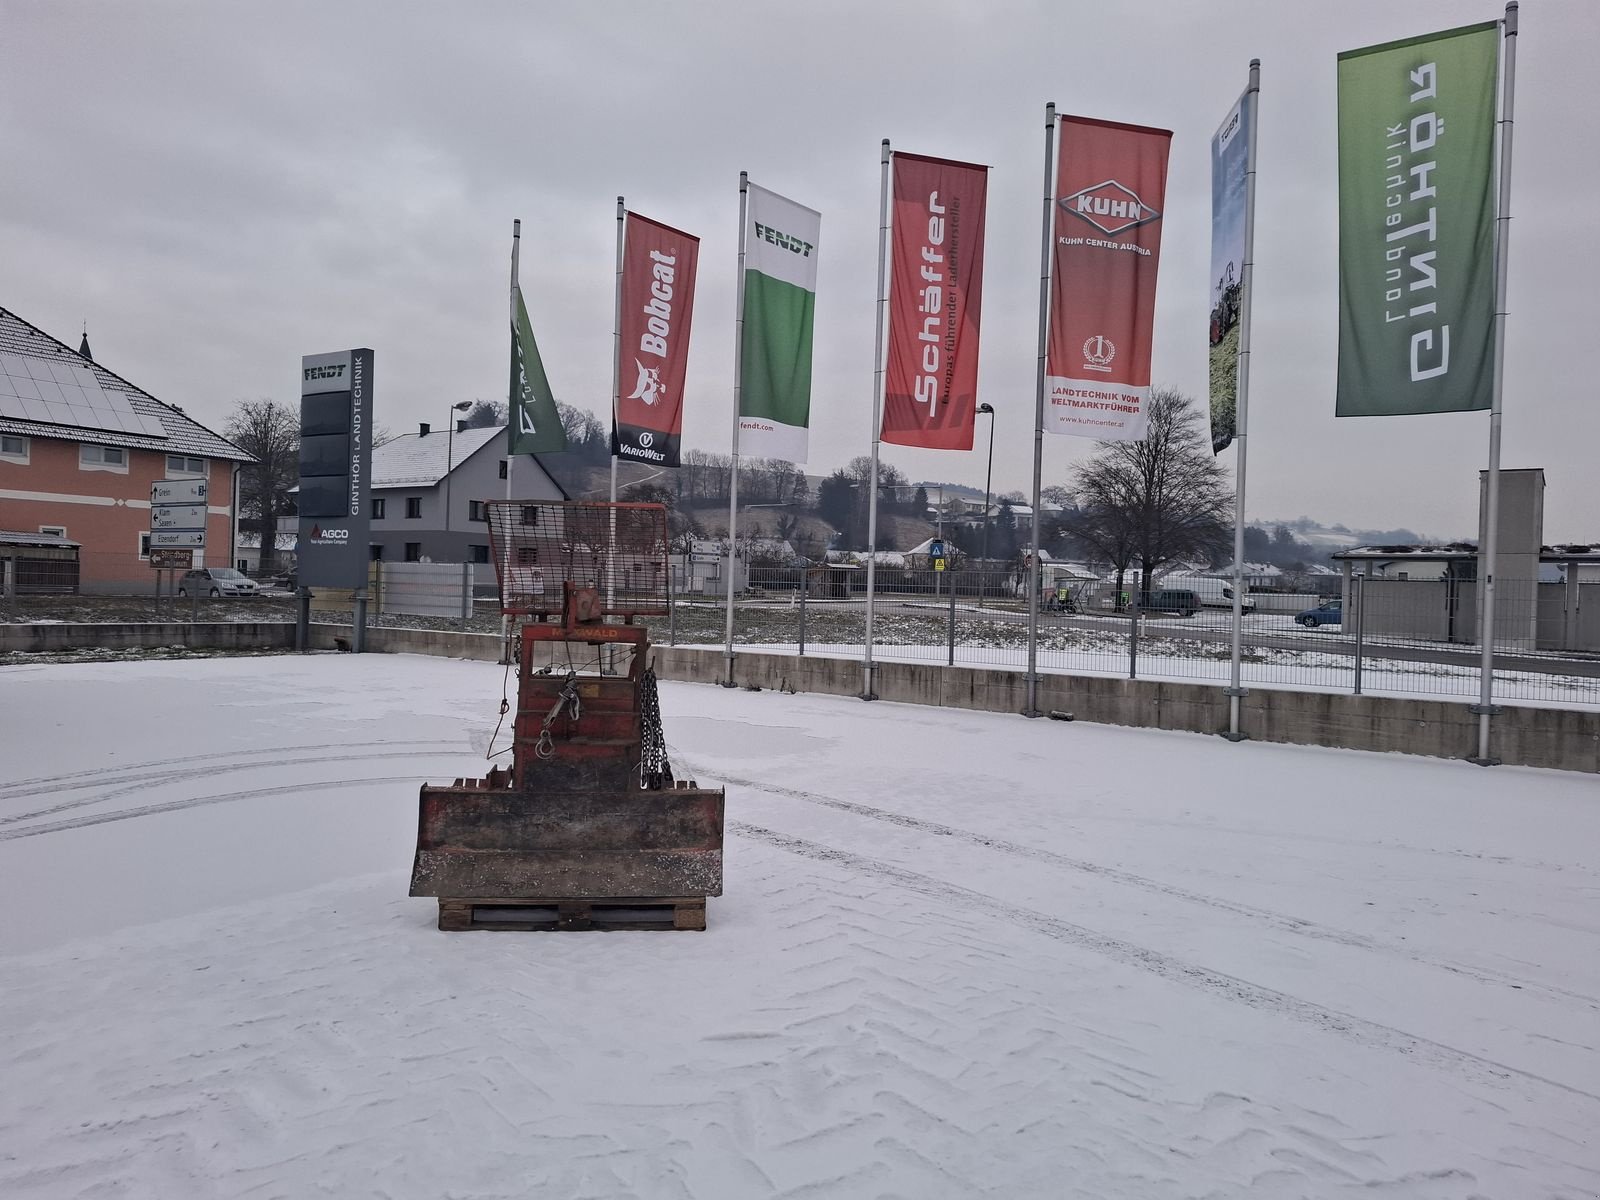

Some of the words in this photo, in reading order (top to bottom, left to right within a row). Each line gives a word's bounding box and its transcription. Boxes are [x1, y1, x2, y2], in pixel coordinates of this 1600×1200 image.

[1077, 195, 1141, 220] KUHN
[754, 221, 814, 258] FENDT
[947, 197, 961, 288] Laderhersteller
[1059, 237, 1083, 245] KUHN
[1086, 238, 1119, 249] CENTER
[1120, 243, 1152, 256] AUSTRIA
[640, 249, 676, 358] Bobcat
[914, 191, 945, 417] Schäffer
[945, 291, 957, 352] führender
[304, 364, 347, 381] FENDT
[942, 355, 954, 405] Europas
[354, 357, 362, 451] LANDTECHNIK
[1051, 397, 1140, 414] WELTMARKTFÜHRER
[1052, 387, 1119, 401] LANDTECHNIK
[1121, 394, 1140, 404] VOM
[740, 421, 774, 432] fendt.com
[1060, 416, 1125, 428] www.kuhncenter.at
[352, 454, 360, 516] GINTHÖR
[321, 529, 349, 539] AGCO
[551, 628, 618, 637] MXWALD
